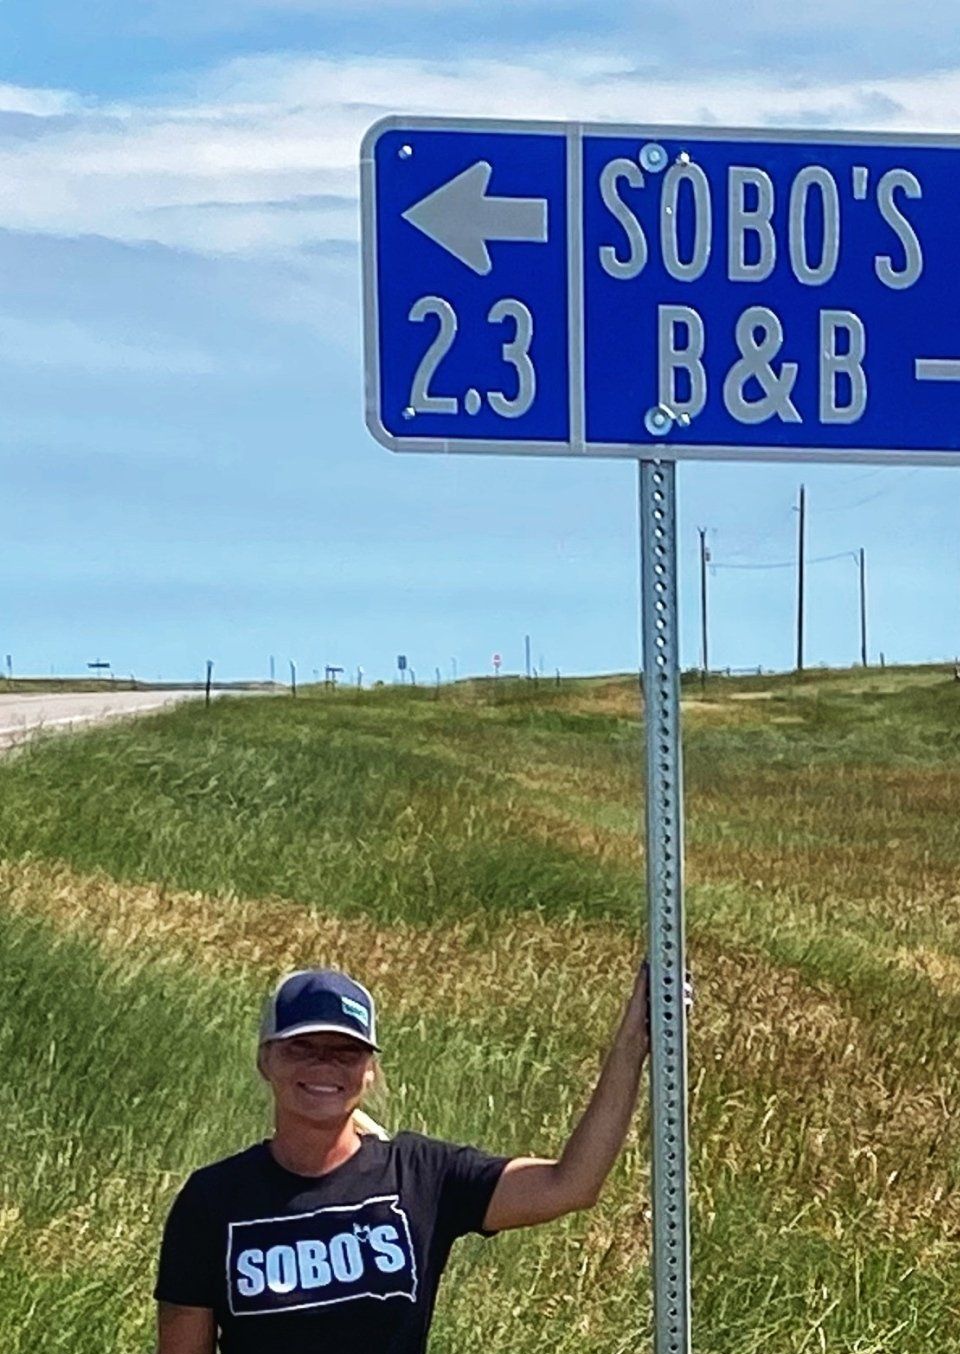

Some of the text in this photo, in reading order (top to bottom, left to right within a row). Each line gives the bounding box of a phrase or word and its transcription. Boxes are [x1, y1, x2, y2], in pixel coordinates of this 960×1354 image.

[600, 158, 923, 290] SOBO'S
[405, 295, 536, 418] 2.3
[657, 304, 869, 425] B&B
